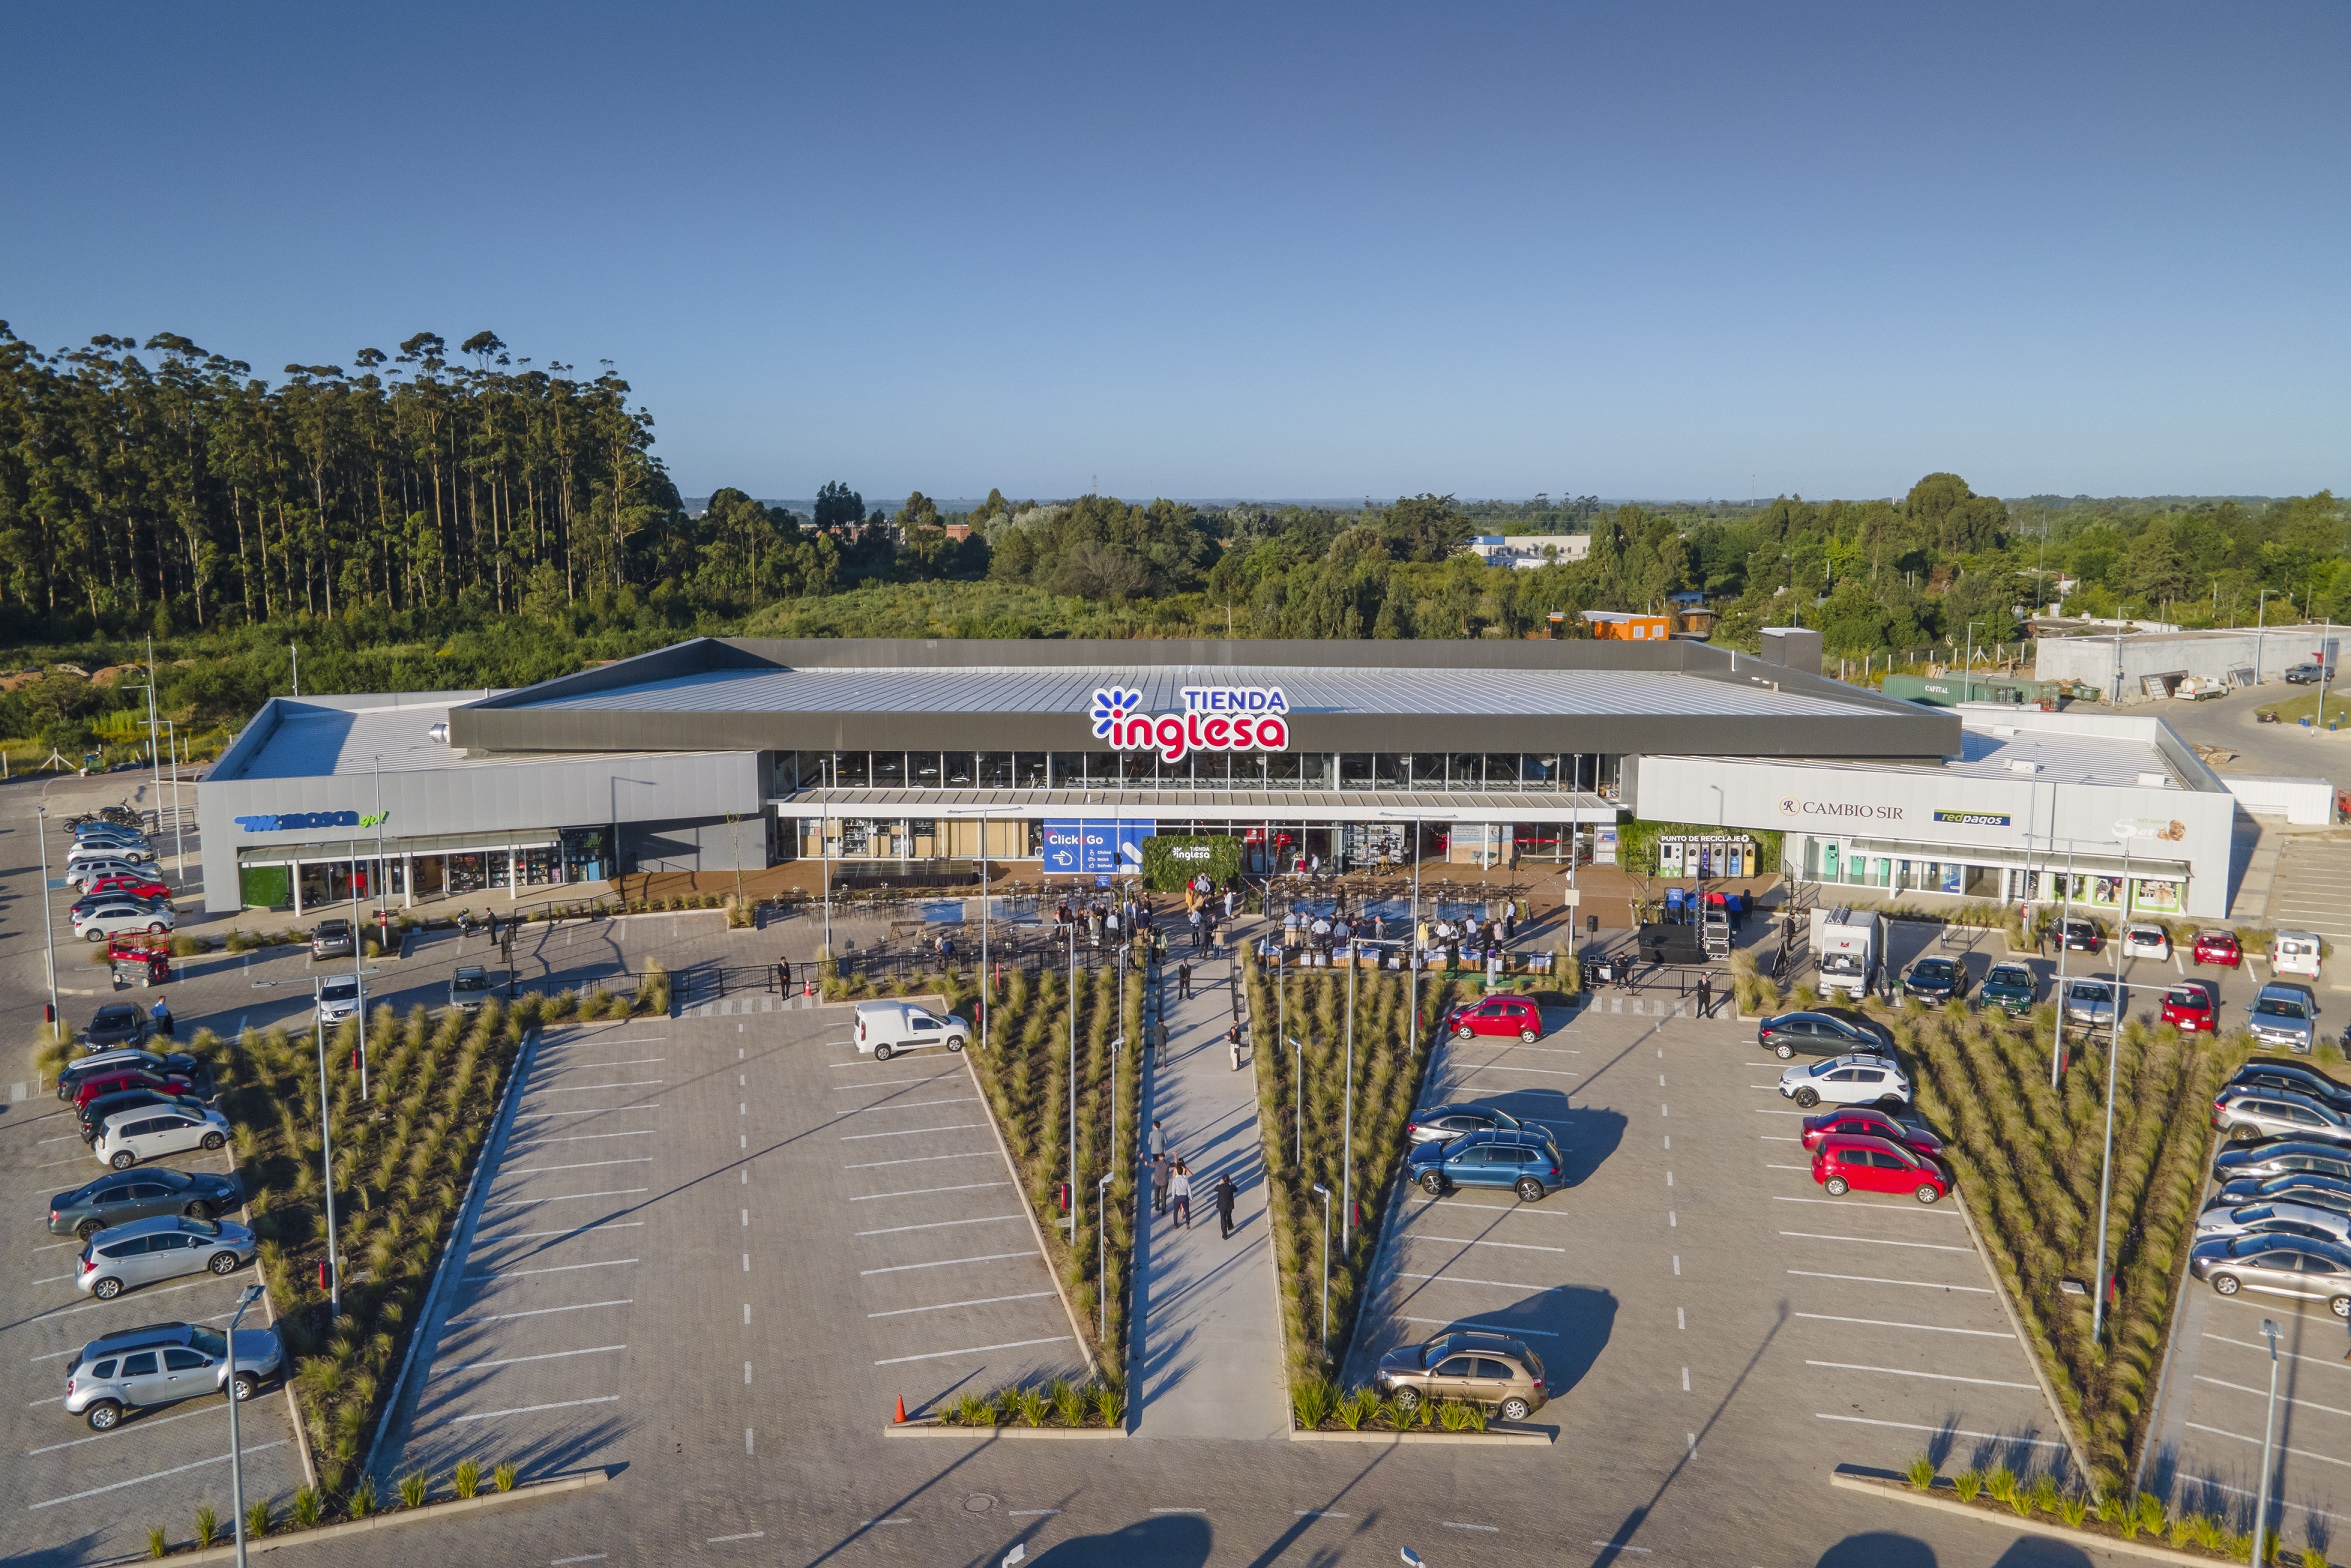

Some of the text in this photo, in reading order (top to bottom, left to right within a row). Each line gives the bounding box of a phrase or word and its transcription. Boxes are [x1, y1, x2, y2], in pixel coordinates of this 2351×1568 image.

[1924, 685, 1949, 694] CAPITAL
[1184, 690, 1286, 710] TIENDA
[1112, 708, 1286, 760] inglesa
[1803, 801, 1874, 818] CAMBIO
[1876, 806, 1904, 820] SIR
[1941, 812, 2003, 825] redpagos
[359, 810, 390, 829] go!
[1049, 834, 1079, 845] Click
[1086, 834, 1104, 845] Go
[1176, 850, 1210, 861] inglesa
